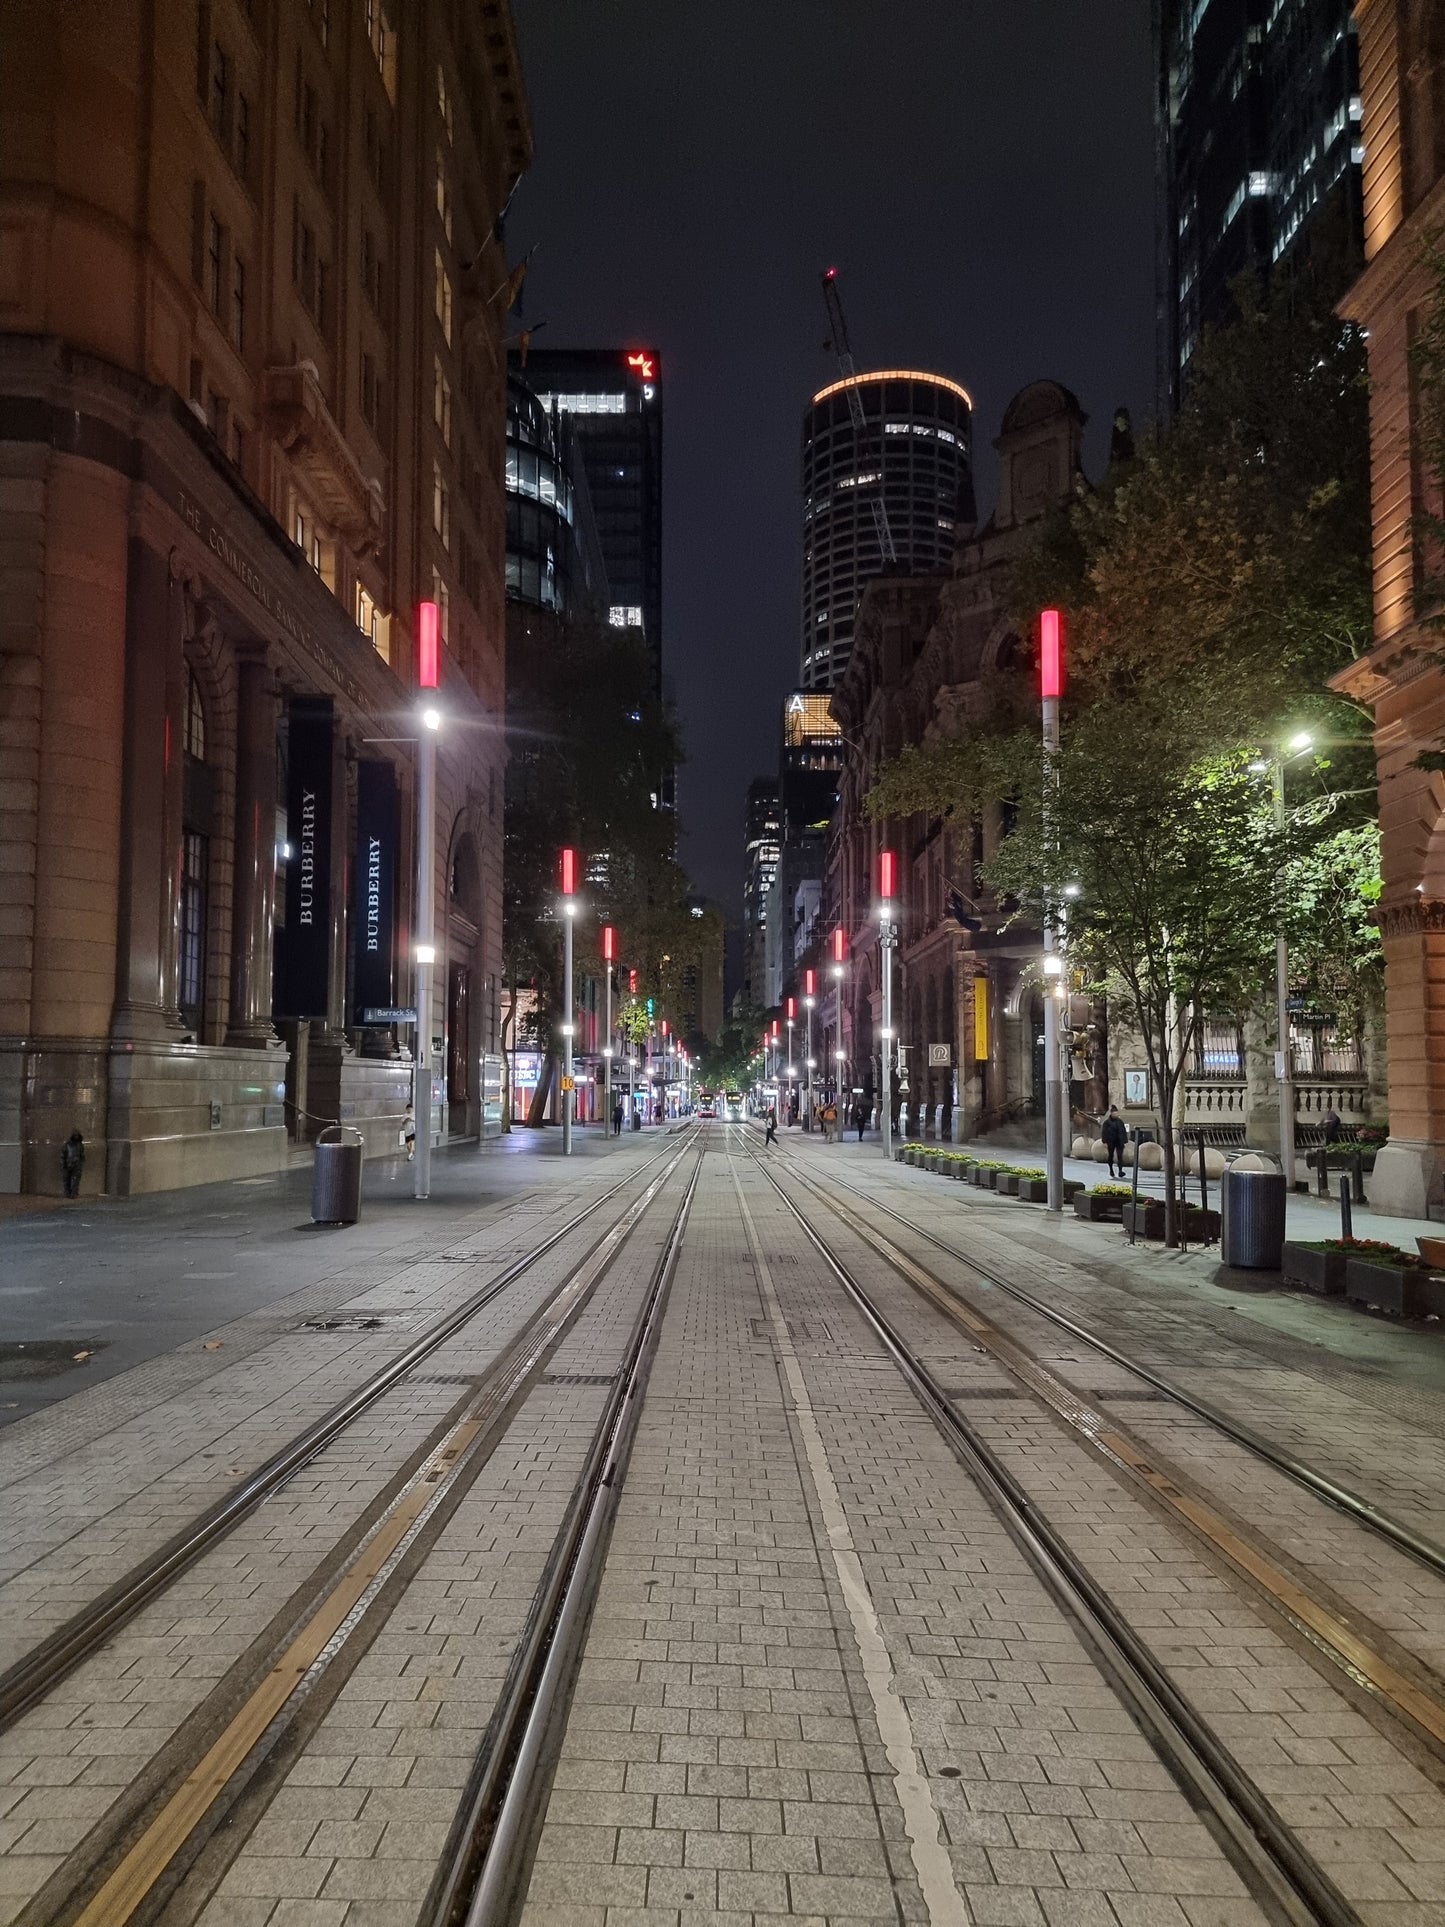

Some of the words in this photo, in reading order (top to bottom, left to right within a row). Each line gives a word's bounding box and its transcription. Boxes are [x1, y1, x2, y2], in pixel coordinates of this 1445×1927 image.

[177, 490, 201, 533] THE
[209, 527, 271, 609] COMMERCIAL
[789, 695, 804, 713] A
[299, 787, 316, 926] BURBERRY
[367, 836, 381, 952] BURBERRY
[377, 1008, 404, 1018] Barrack
[405, 1008, 414, 1018] St
[563, 1078, 574, 1088] 10
